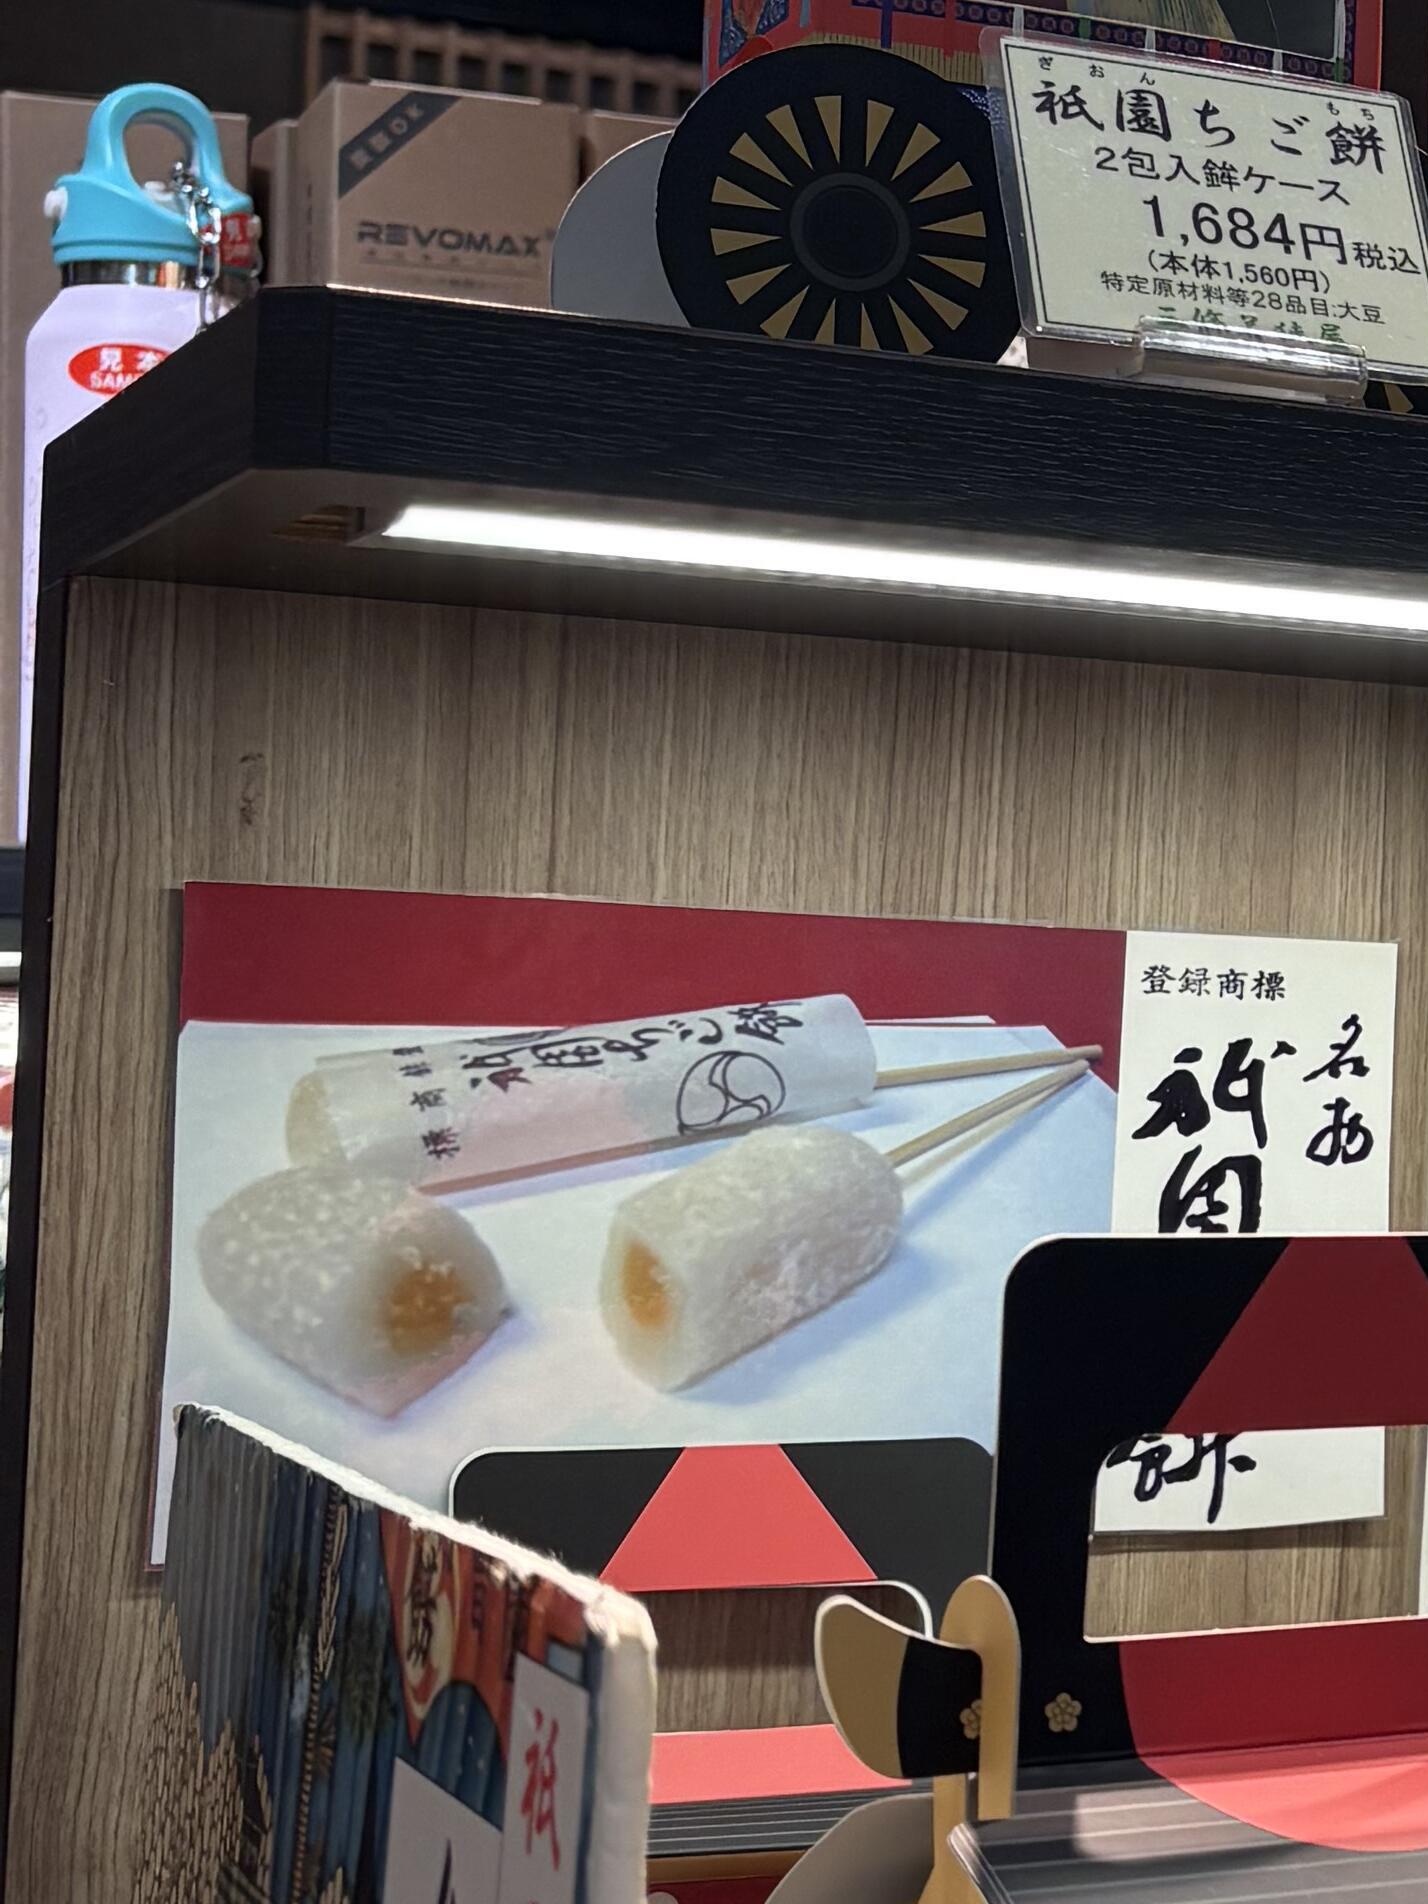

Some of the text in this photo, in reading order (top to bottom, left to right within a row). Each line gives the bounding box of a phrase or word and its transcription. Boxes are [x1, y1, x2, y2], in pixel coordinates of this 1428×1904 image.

[1031, 79, 1387, 175] 祇園ちご餅
[1095, 146, 1351, 206] 2包入鉾ケース
[356, 219, 541, 259] REVOMAX
[1148, 249, 1332, 294] (本体1,560円)
[89, 370, 143, 389] SAM
[99, 347, 162, 372] 見本
[1142, 962, 1289, 1002] 登録商標
